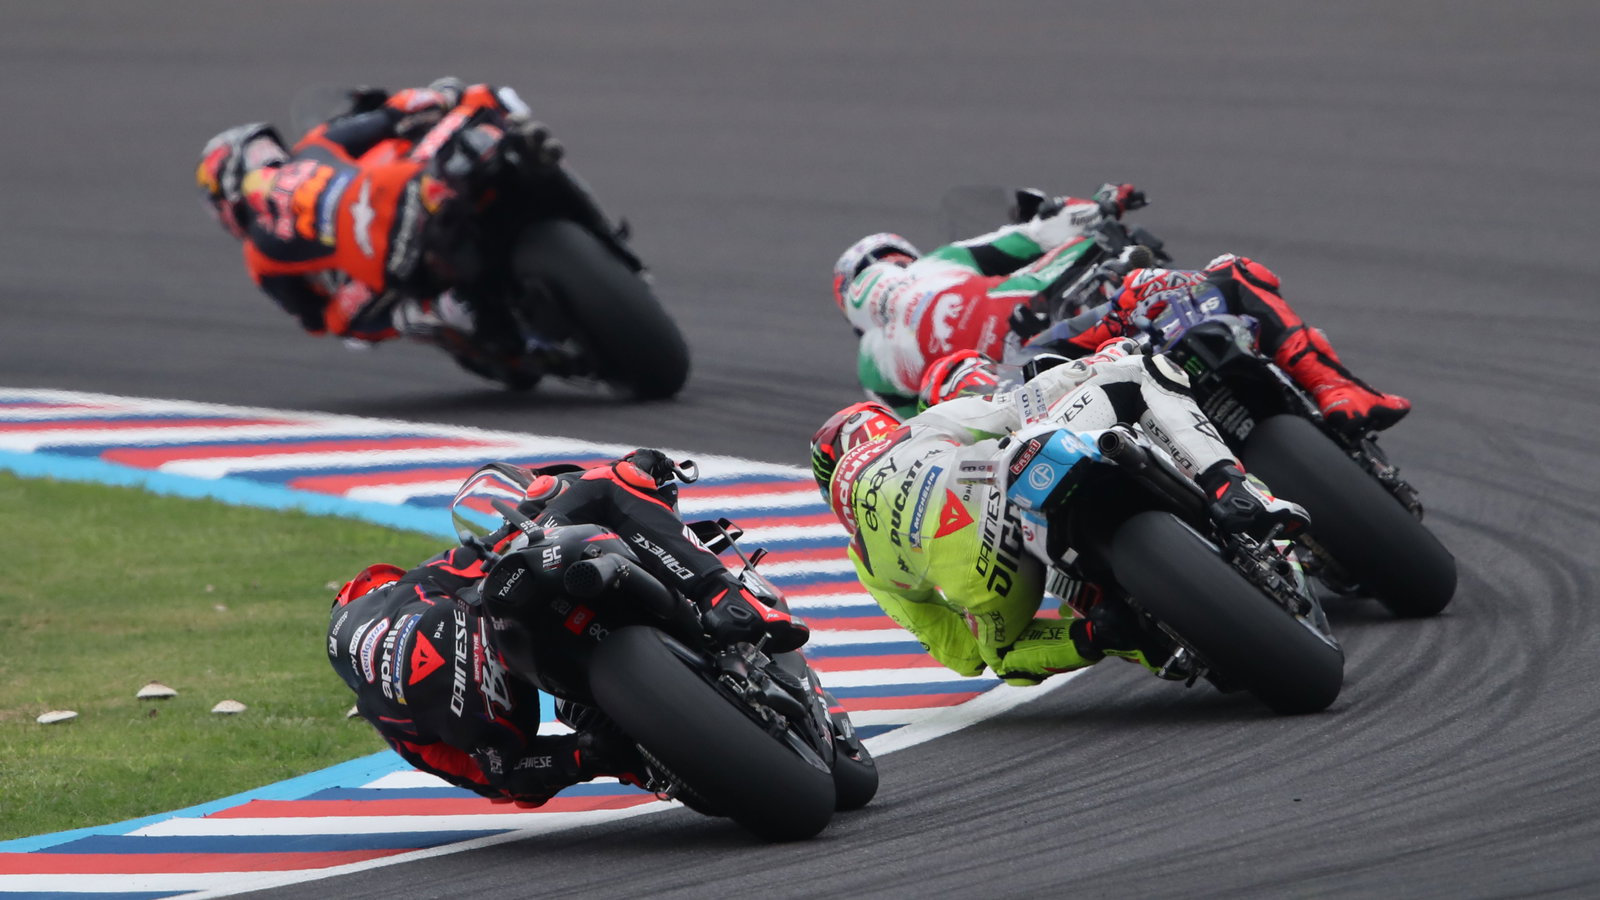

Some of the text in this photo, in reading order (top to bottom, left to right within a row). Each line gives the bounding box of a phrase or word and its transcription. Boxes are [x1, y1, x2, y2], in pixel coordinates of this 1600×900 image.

[1011, 441, 1040, 474] FASSI
[1147, 421, 1192, 470] DAINESE
[861, 457, 898, 532] ebay
[891, 460, 923, 547] DUCATI
[913, 471, 936, 529] MICHELIN
[542, 544, 562, 563] SC
[631, 533, 695, 580] DAINESE
[976, 484, 1001, 578] DAINES
[498, 567, 525, 598] TARGA
[361, 621, 386, 679] sterilgarda
[381, 614, 409, 700] aprilia
[396, 619, 414, 679] MICHELIN
[450, 609, 466, 718] DAINESE
